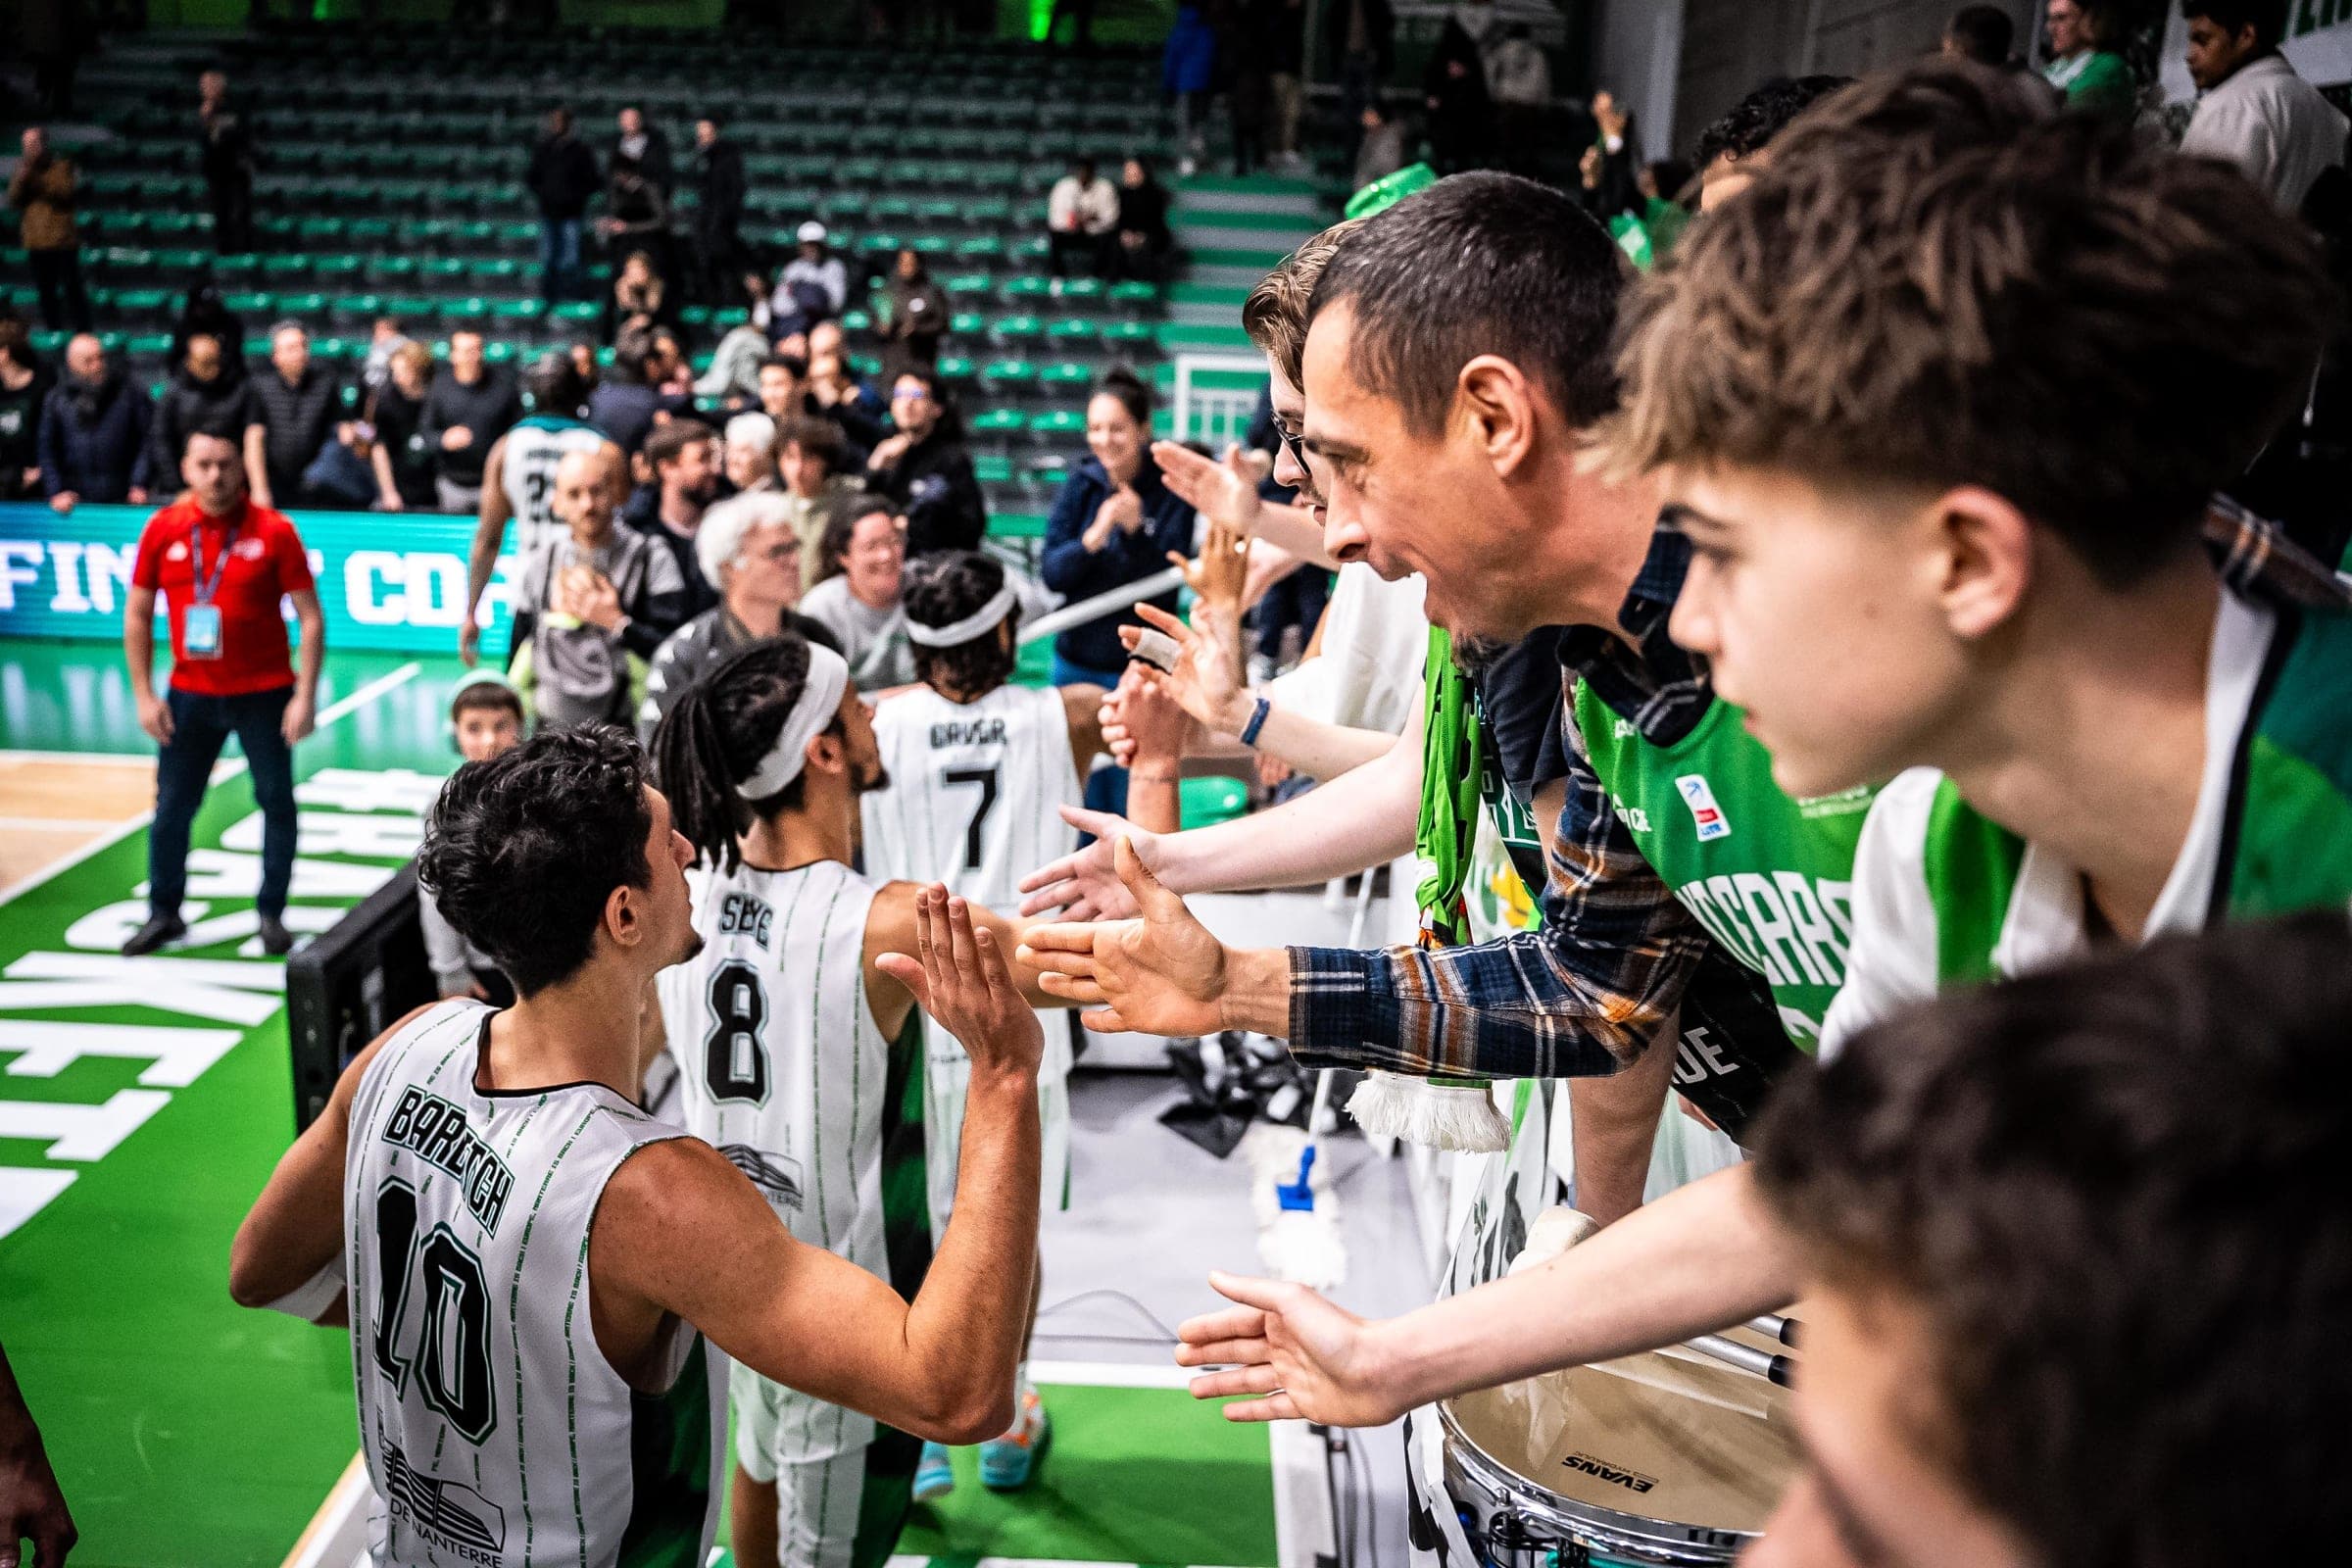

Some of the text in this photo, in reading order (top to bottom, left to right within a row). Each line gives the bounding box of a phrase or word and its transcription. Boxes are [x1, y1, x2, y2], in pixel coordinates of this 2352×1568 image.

[943, 760, 1004, 872] 7
[703, 958, 772, 1111] 8
[371, 1175, 498, 1447] 10
[1561, 1455, 1656, 1494] EVANS
[390, 1497, 503, 1568] DE NANTERRE
